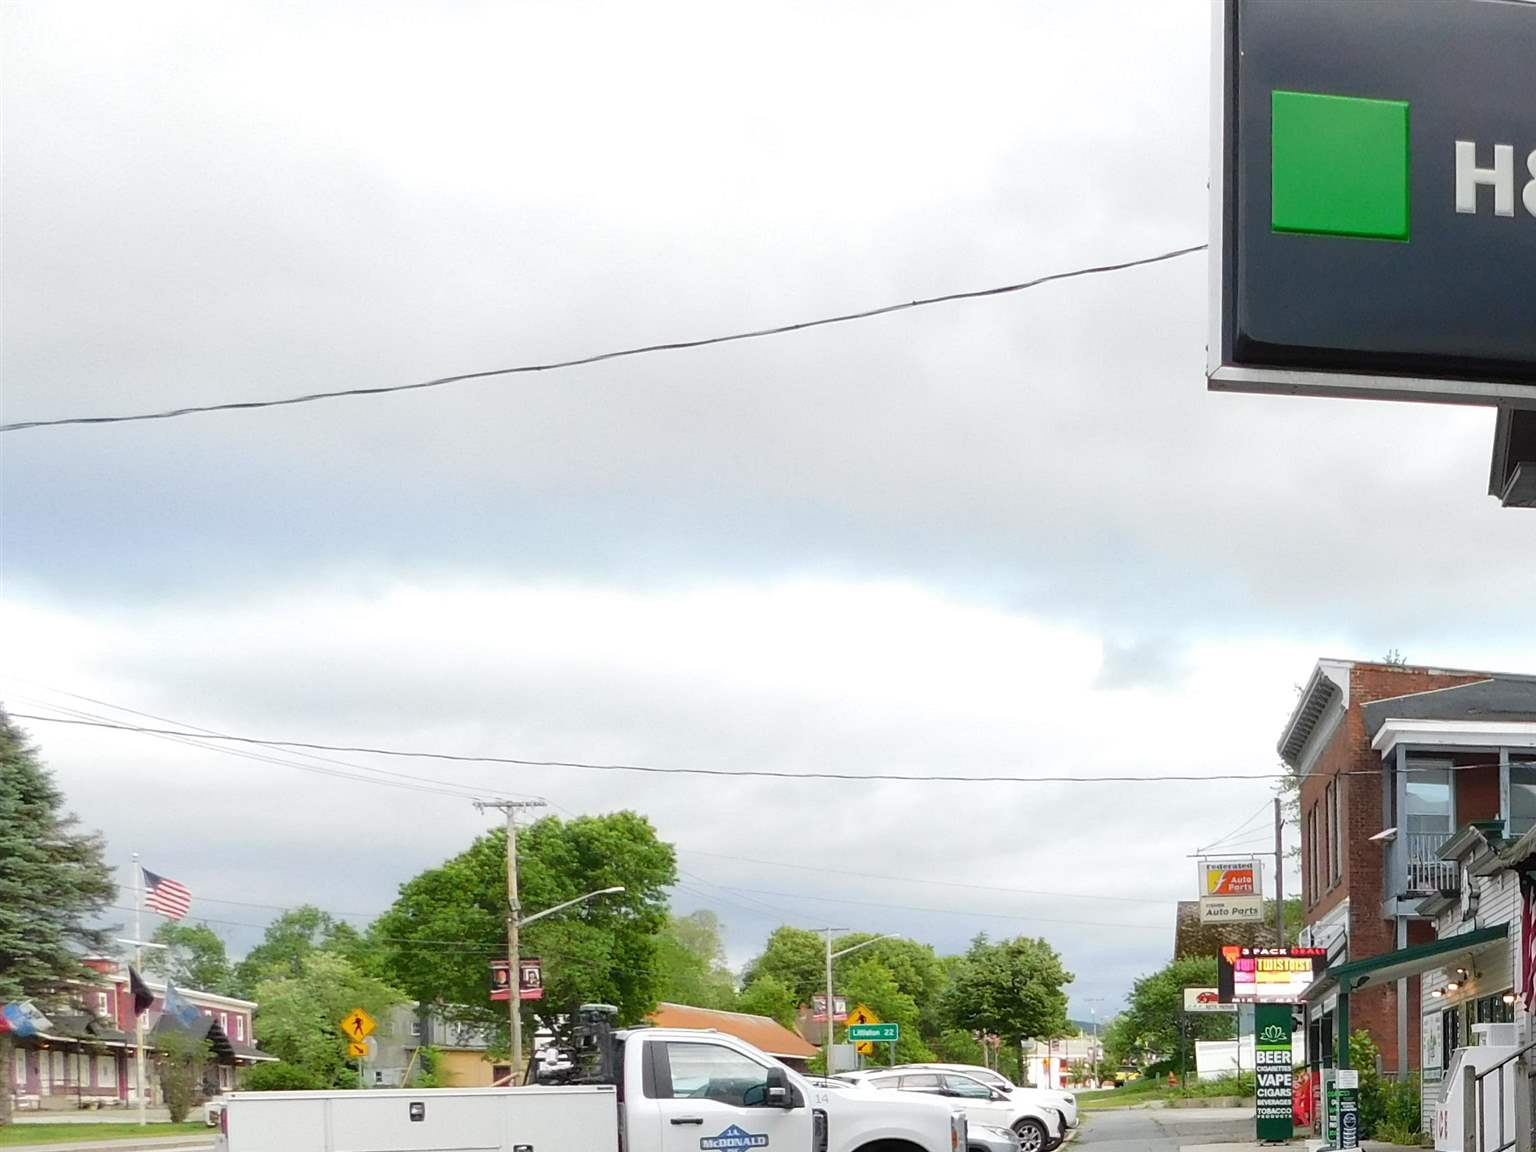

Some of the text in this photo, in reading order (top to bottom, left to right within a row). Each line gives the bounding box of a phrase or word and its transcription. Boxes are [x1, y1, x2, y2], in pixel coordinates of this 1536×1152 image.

[1206, 907, 1258, 916] Auto Parts
[884, 1028, 894, 1036] 22
[1256, 1051, 1291, 1063] BEER
[1257, 1074, 1291, 1086] VAPE
[1257, 1088, 1291, 1097] CIGARS
[1257, 1107, 1292, 1115] TOBACCO
